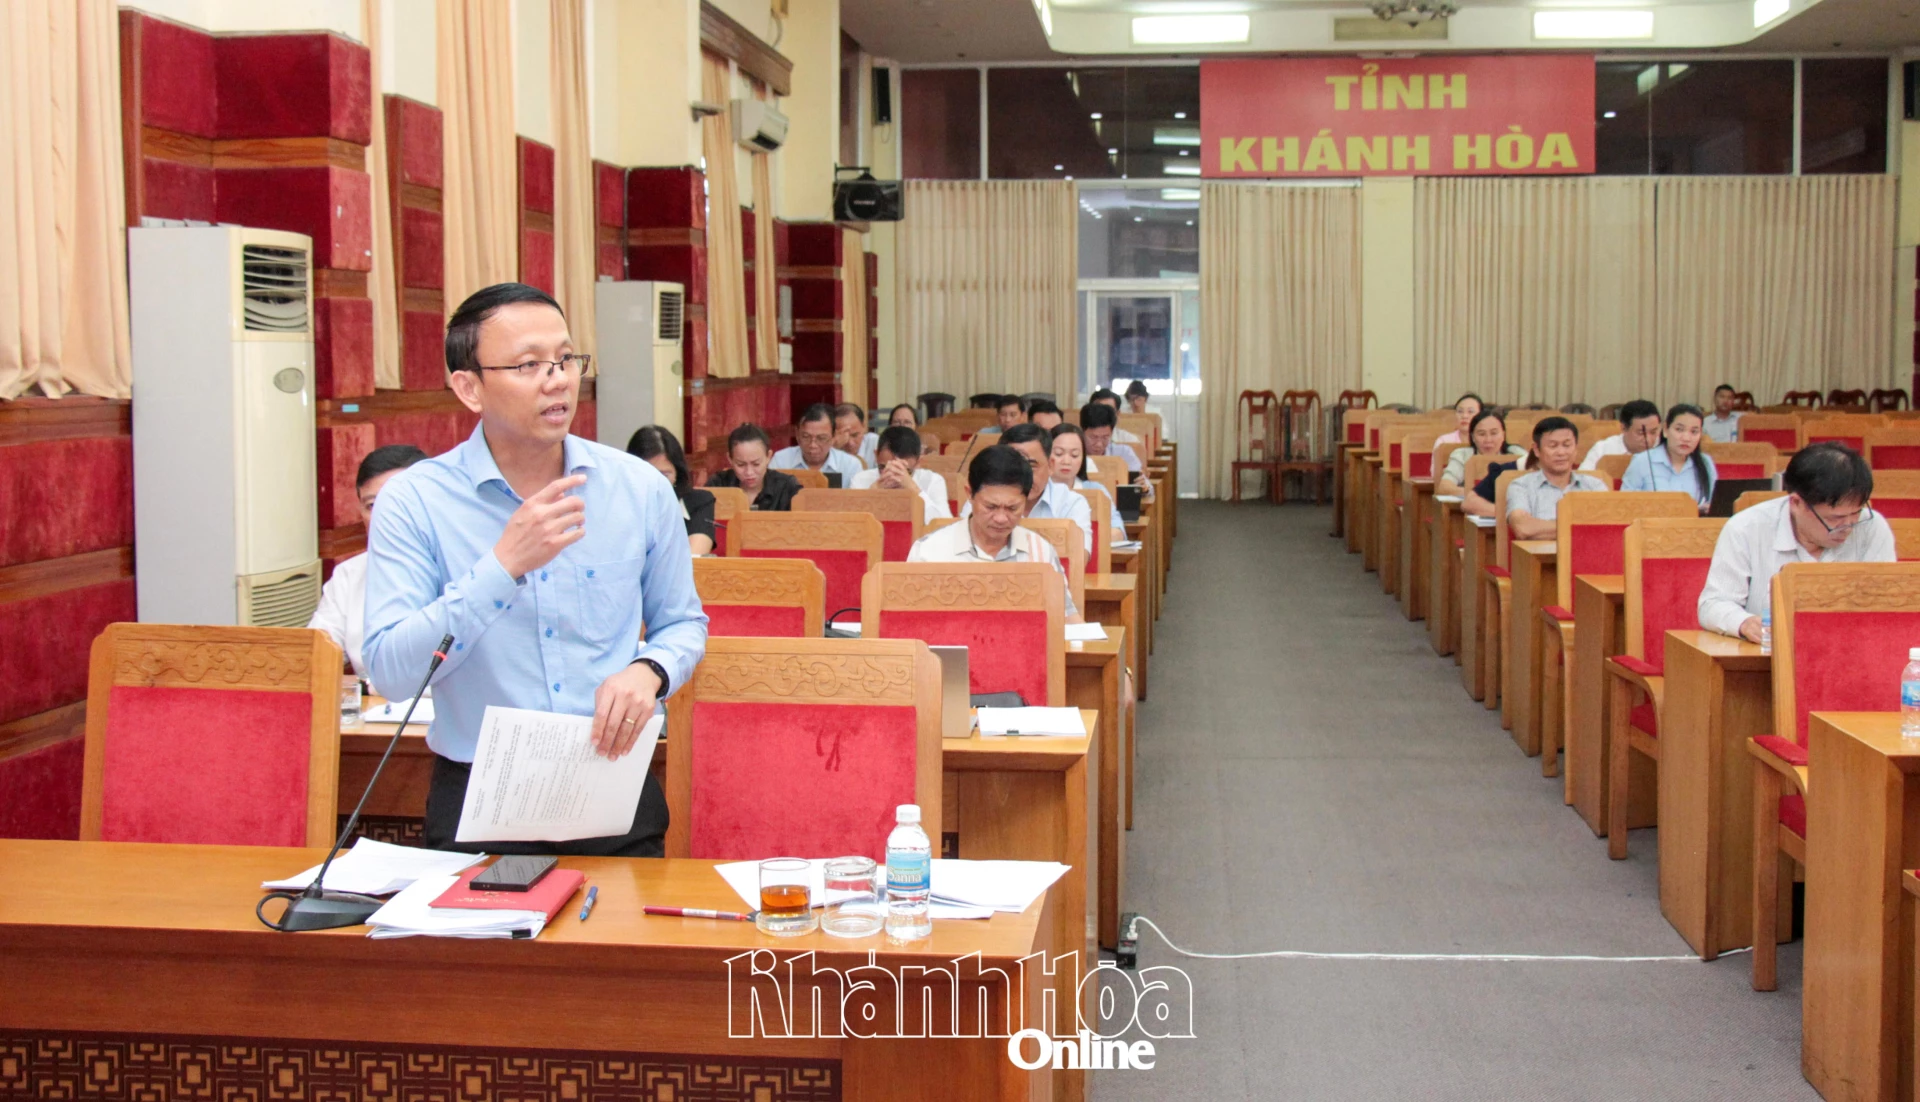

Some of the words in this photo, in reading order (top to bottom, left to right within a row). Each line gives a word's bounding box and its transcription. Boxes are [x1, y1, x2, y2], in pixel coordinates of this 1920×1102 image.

[1325, 63, 1467, 111] TỈNH
[1219, 129, 1430, 172] KHÁNH
[1453, 125, 1578, 169] HÒA
